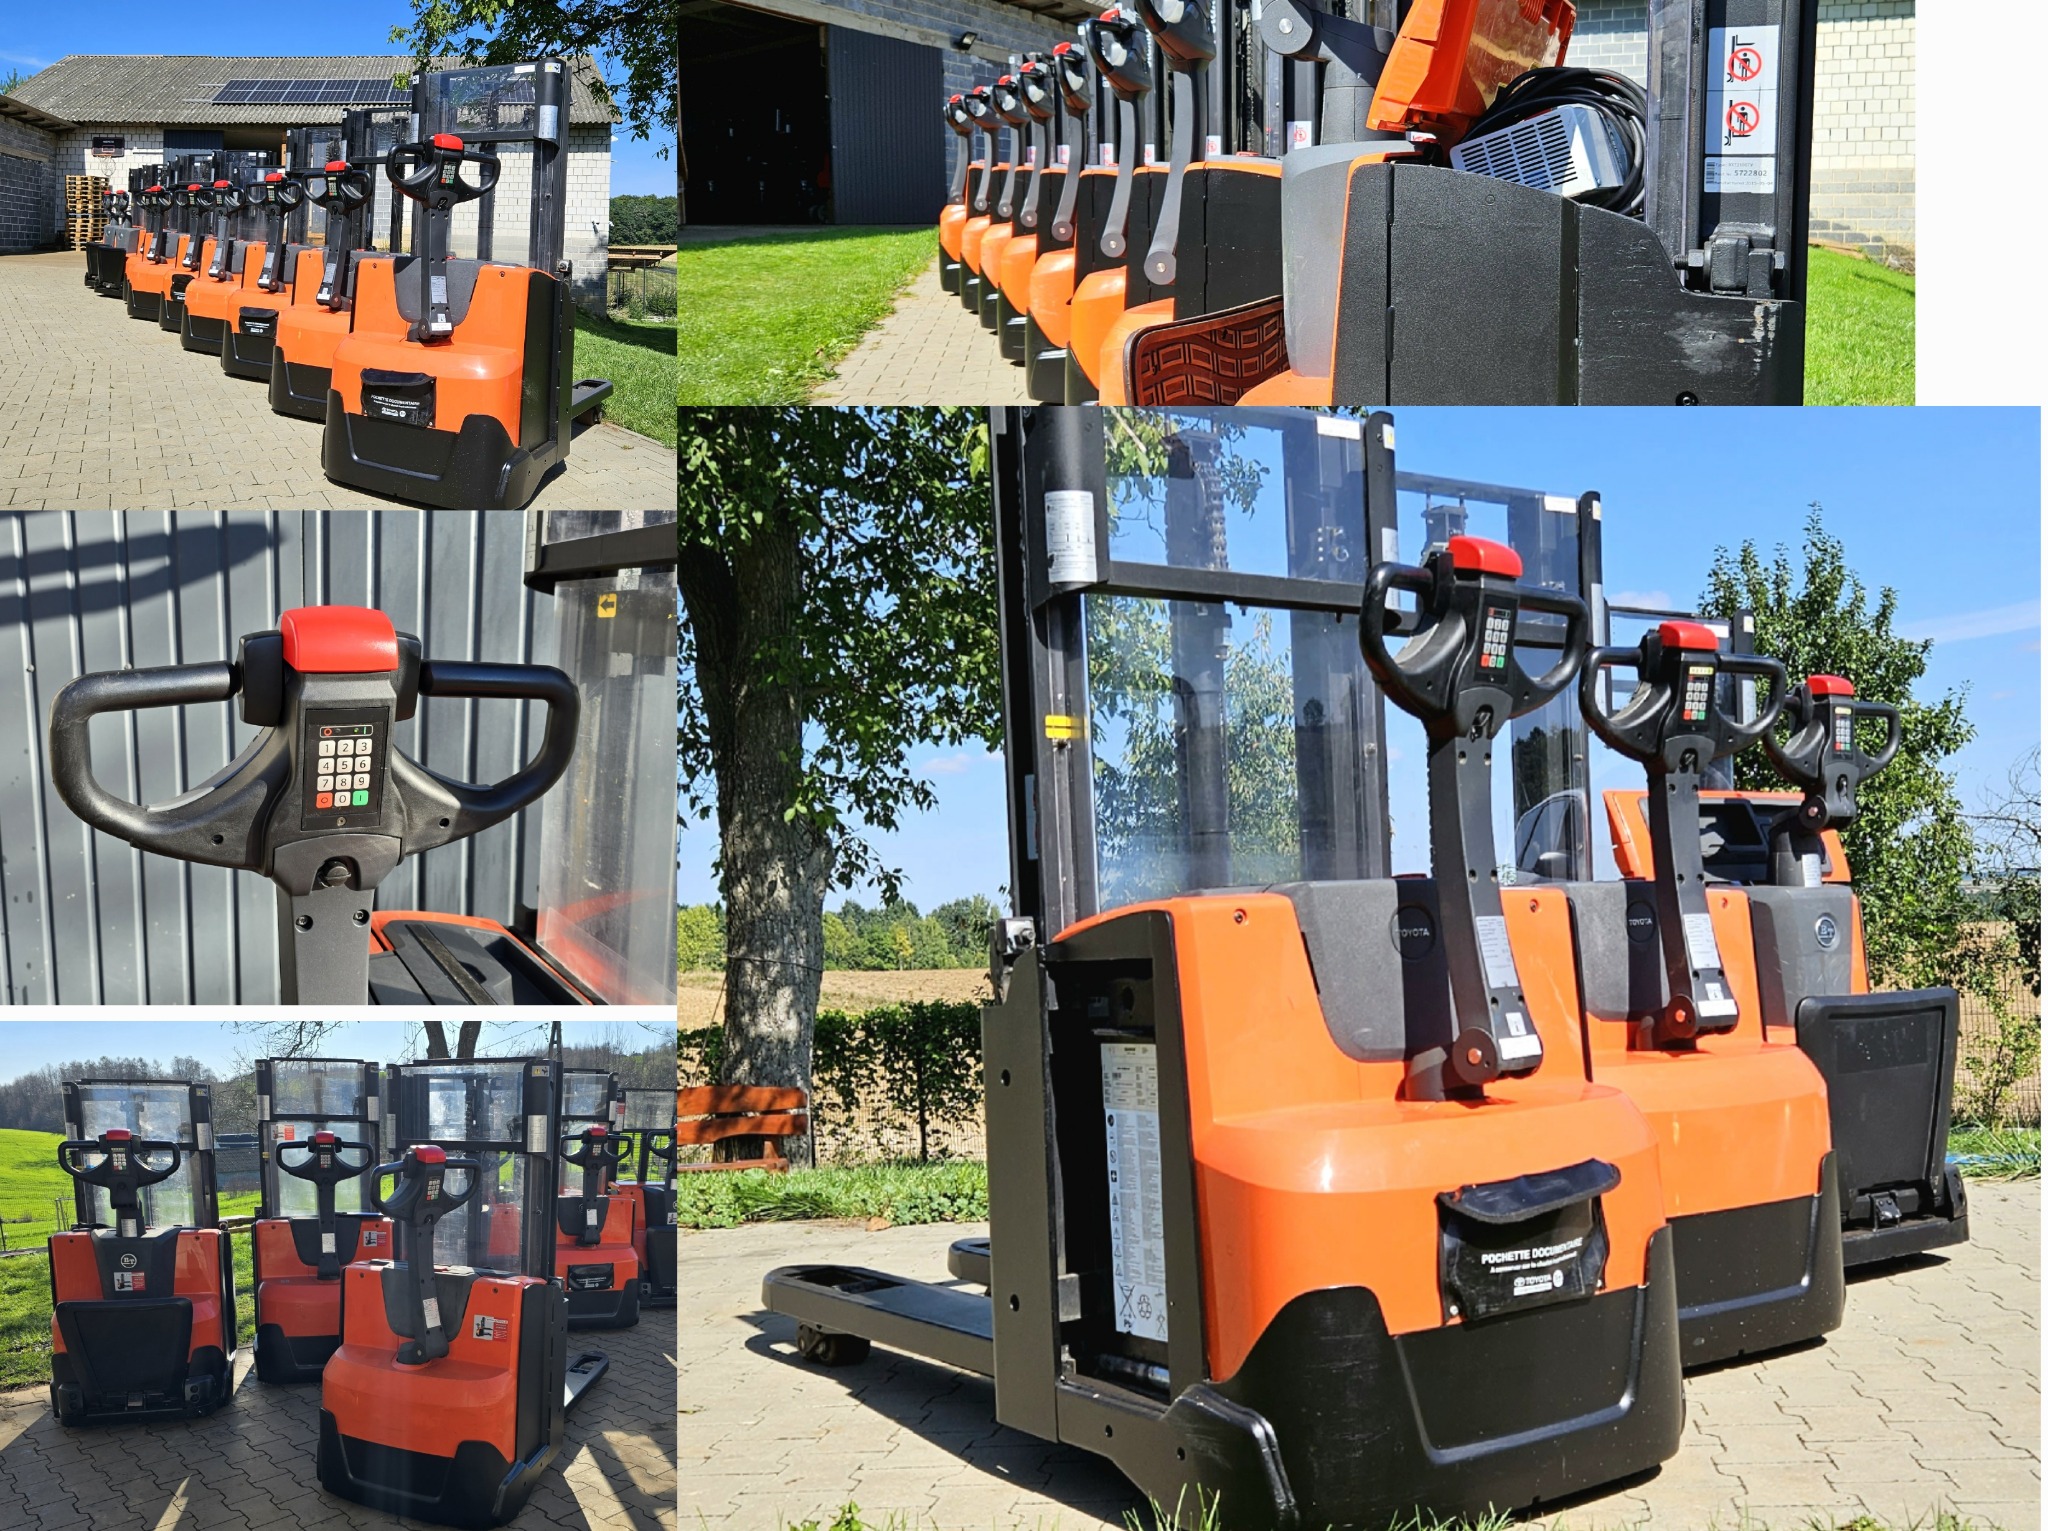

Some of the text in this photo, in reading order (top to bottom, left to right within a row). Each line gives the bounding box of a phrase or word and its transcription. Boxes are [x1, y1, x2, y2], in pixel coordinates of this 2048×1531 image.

[343, 743, 348, 752] 2
[361, 742, 367, 751] 3
[323, 760, 366, 771] 4 5 6
[323, 777, 365, 788] 7 8 9
[1481, 1250, 1531, 1265] POCHETTE
